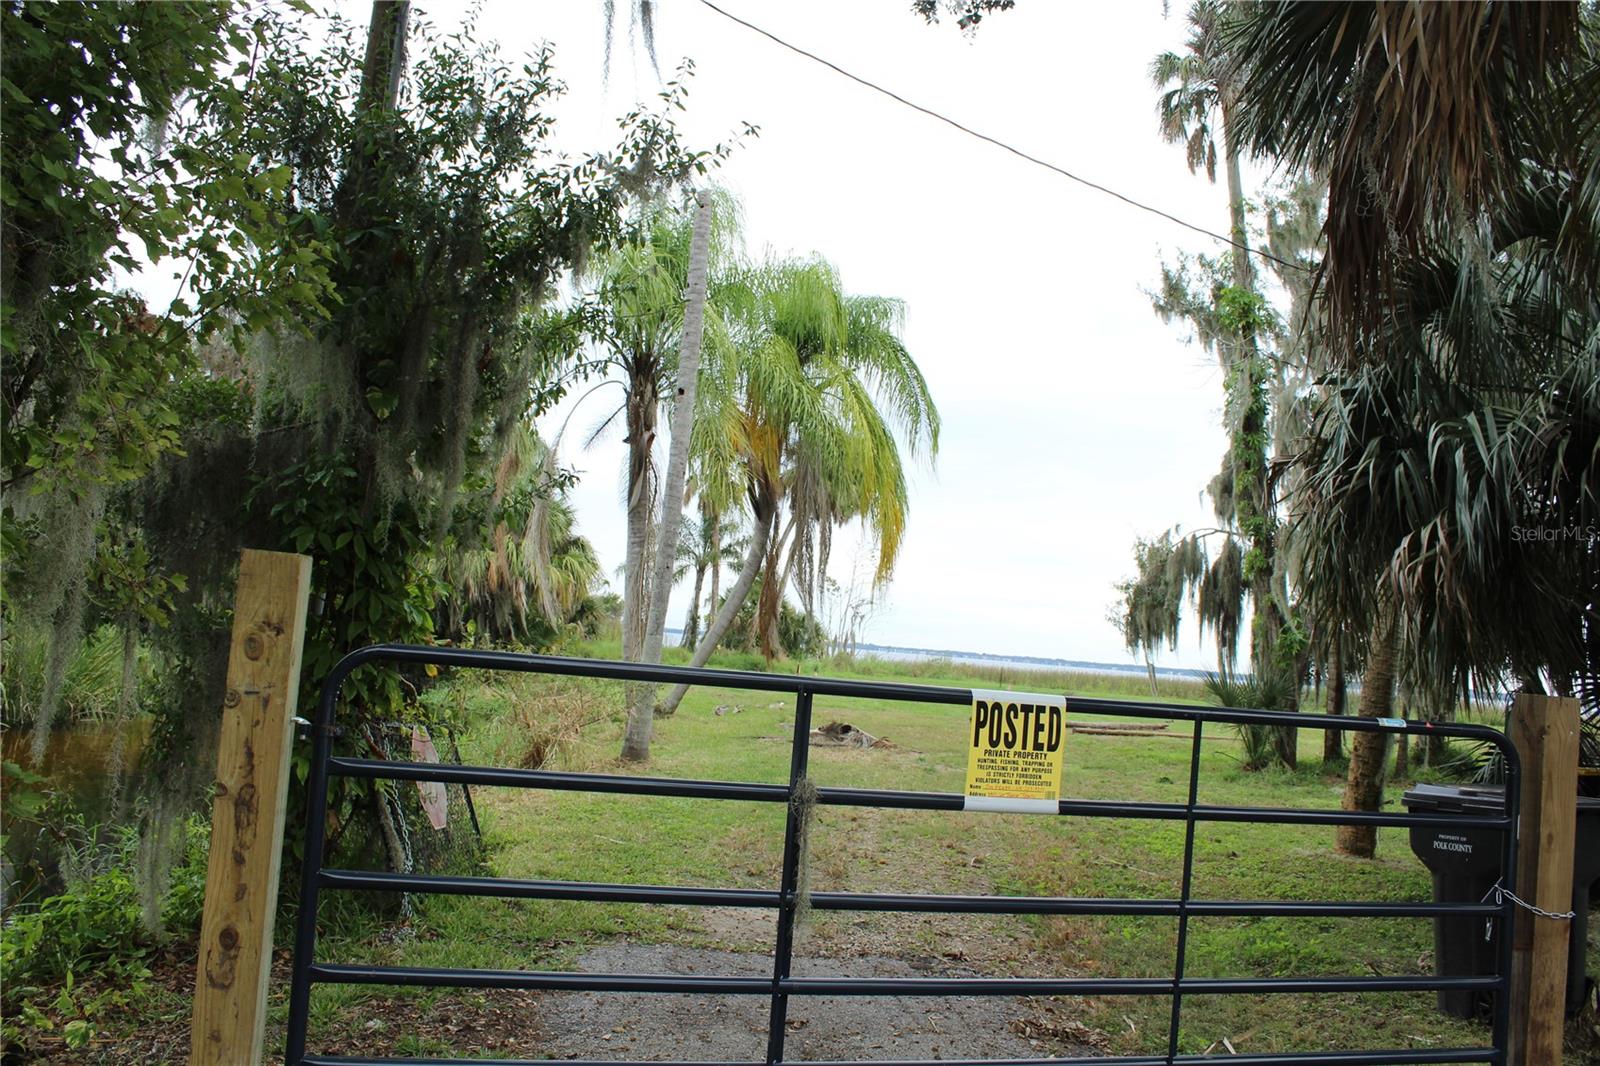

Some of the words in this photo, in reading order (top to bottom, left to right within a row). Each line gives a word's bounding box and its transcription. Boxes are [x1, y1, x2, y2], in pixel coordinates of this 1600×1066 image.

[974, 701, 1061, 752] POSTED
[984, 749, 1010, 758] PRIVATE
[1013, 751, 1047, 760] PROPERTY
[1433, 840, 1448, 849] POLK
[1448, 842, 1472, 853] COUNTY
